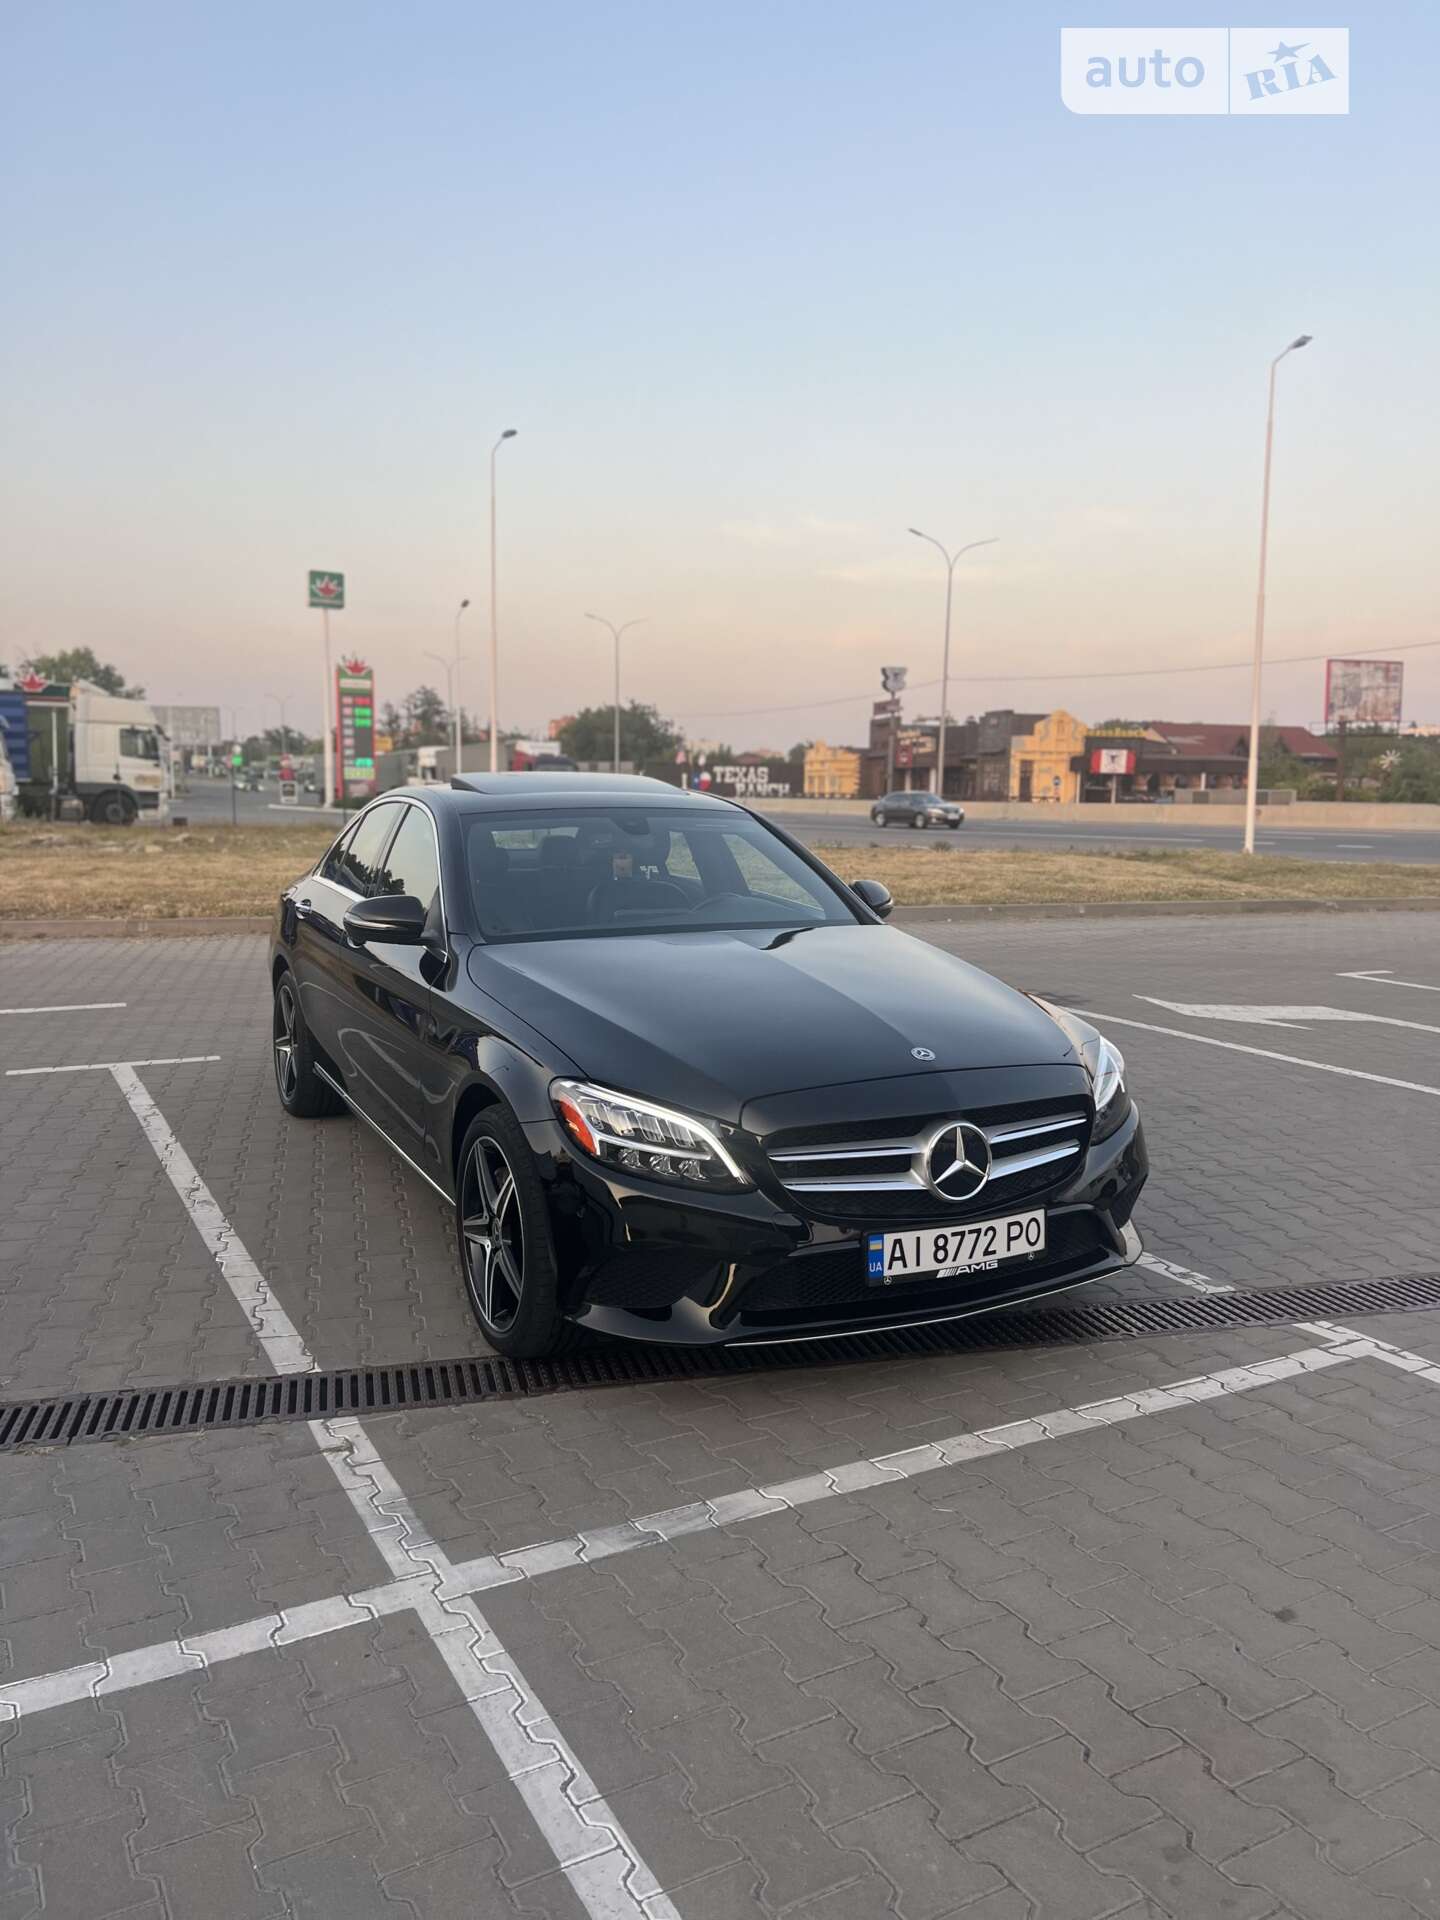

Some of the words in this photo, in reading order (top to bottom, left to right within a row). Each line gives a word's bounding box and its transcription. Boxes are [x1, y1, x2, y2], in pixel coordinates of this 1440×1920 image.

[713, 766, 769, 783] TEXAS
[735, 783, 790, 798] RANCH
[887, 1236, 921, 1270] AI
[933, 1225, 997, 1264] 8772
[1006, 1217, 1041, 1252] PO
[869, 1261, 883, 1273] UA
[955, 1259, 999, 1276] AMG
